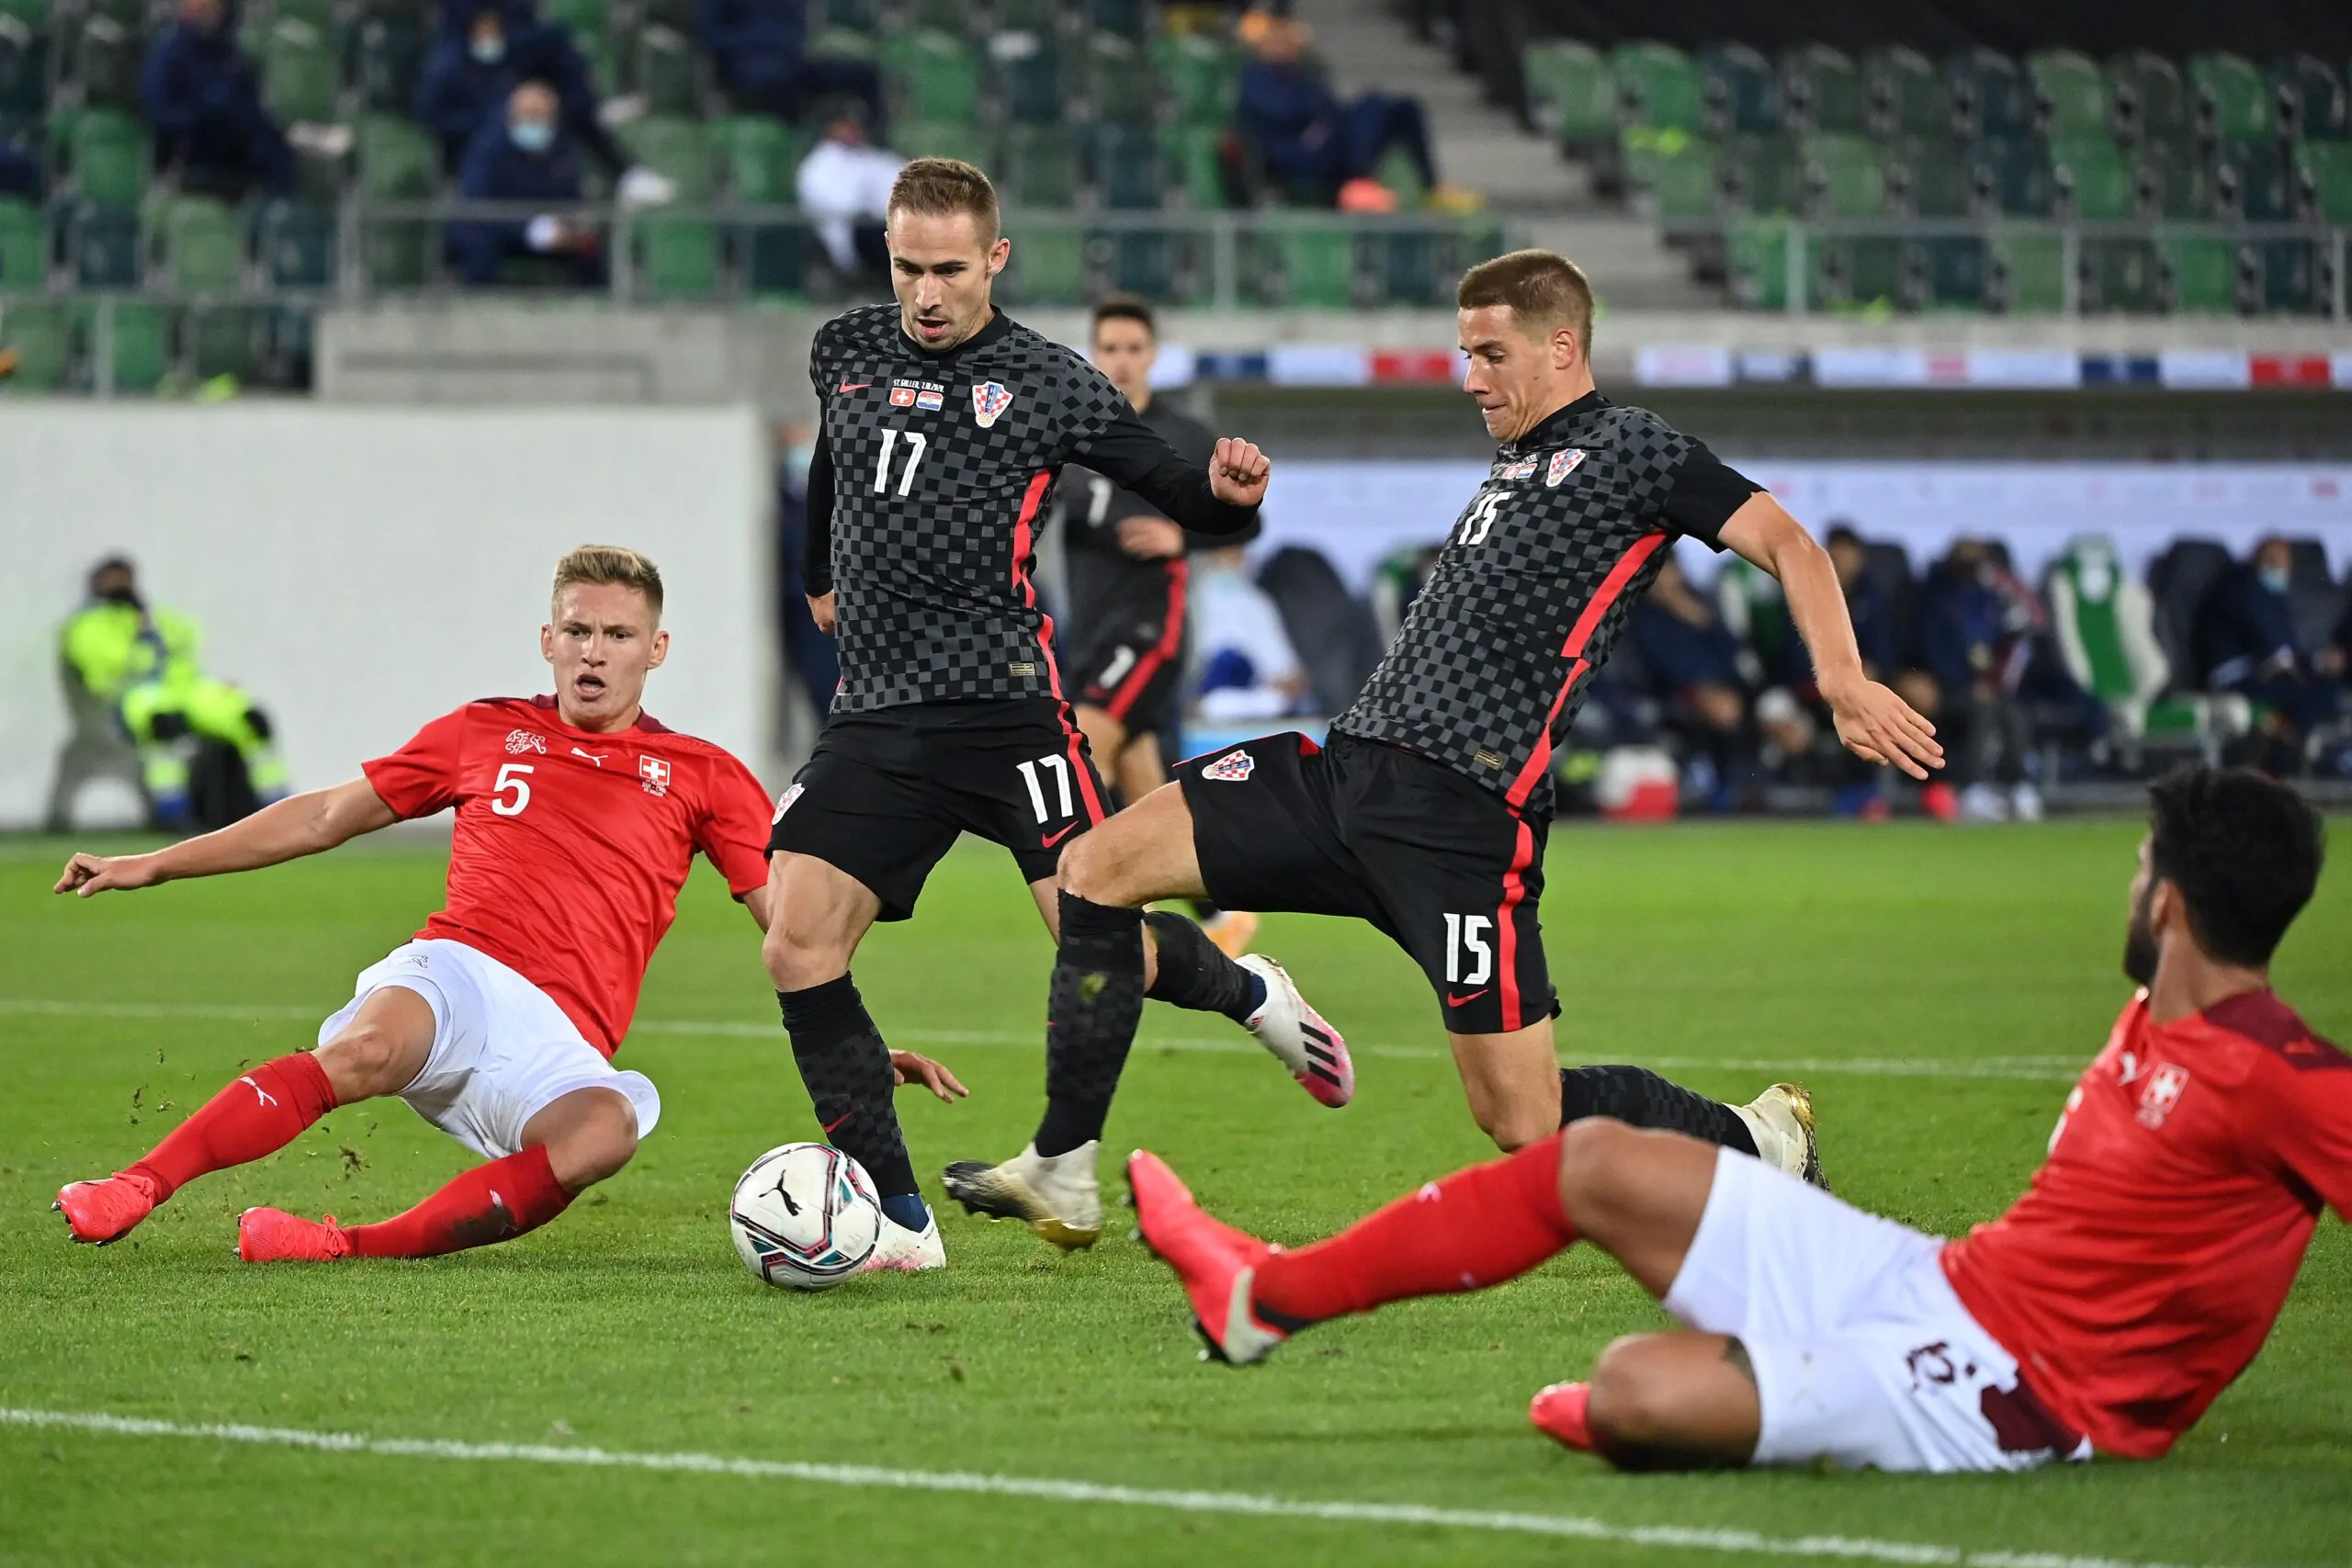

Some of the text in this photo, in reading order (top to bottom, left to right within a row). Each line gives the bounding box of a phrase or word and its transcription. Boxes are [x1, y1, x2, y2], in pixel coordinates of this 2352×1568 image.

[874, 428, 927, 496] 17
[1457, 491, 1511, 546] 15
[492, 763, 535, 816] 5
[1015, 753, 1074, 824] 17
[1442, 912, 1493, 986] 15
